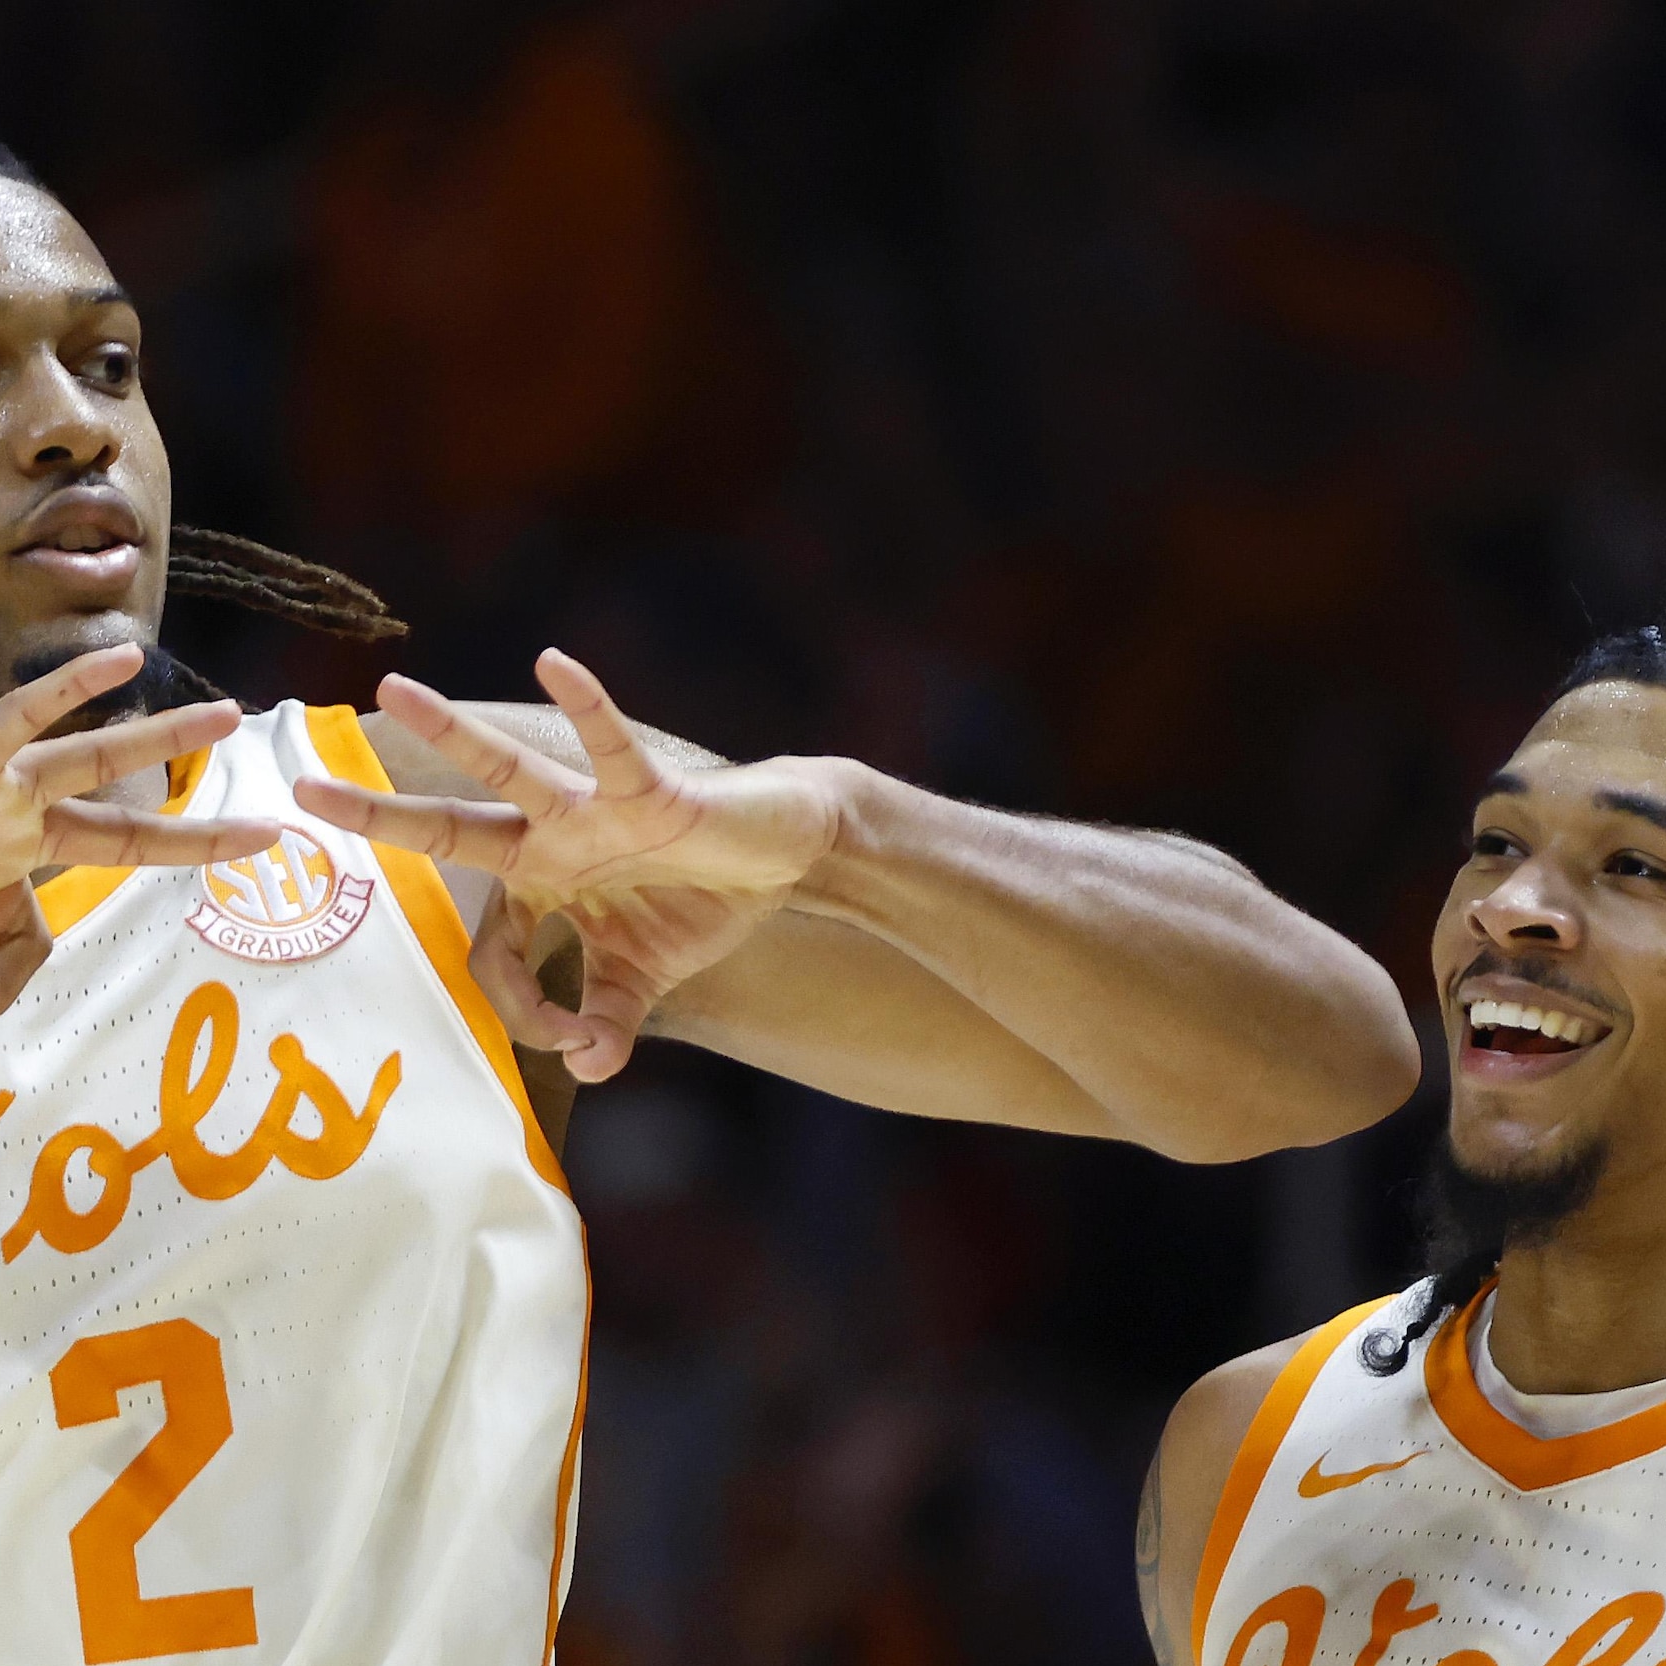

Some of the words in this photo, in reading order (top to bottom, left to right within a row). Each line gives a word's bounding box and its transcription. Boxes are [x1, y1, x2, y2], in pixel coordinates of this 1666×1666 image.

[211, 829, 329, 923] SEC
[217, 903, 359, 959] GRADUATE
[49, 1317, 258, 1665] 2
